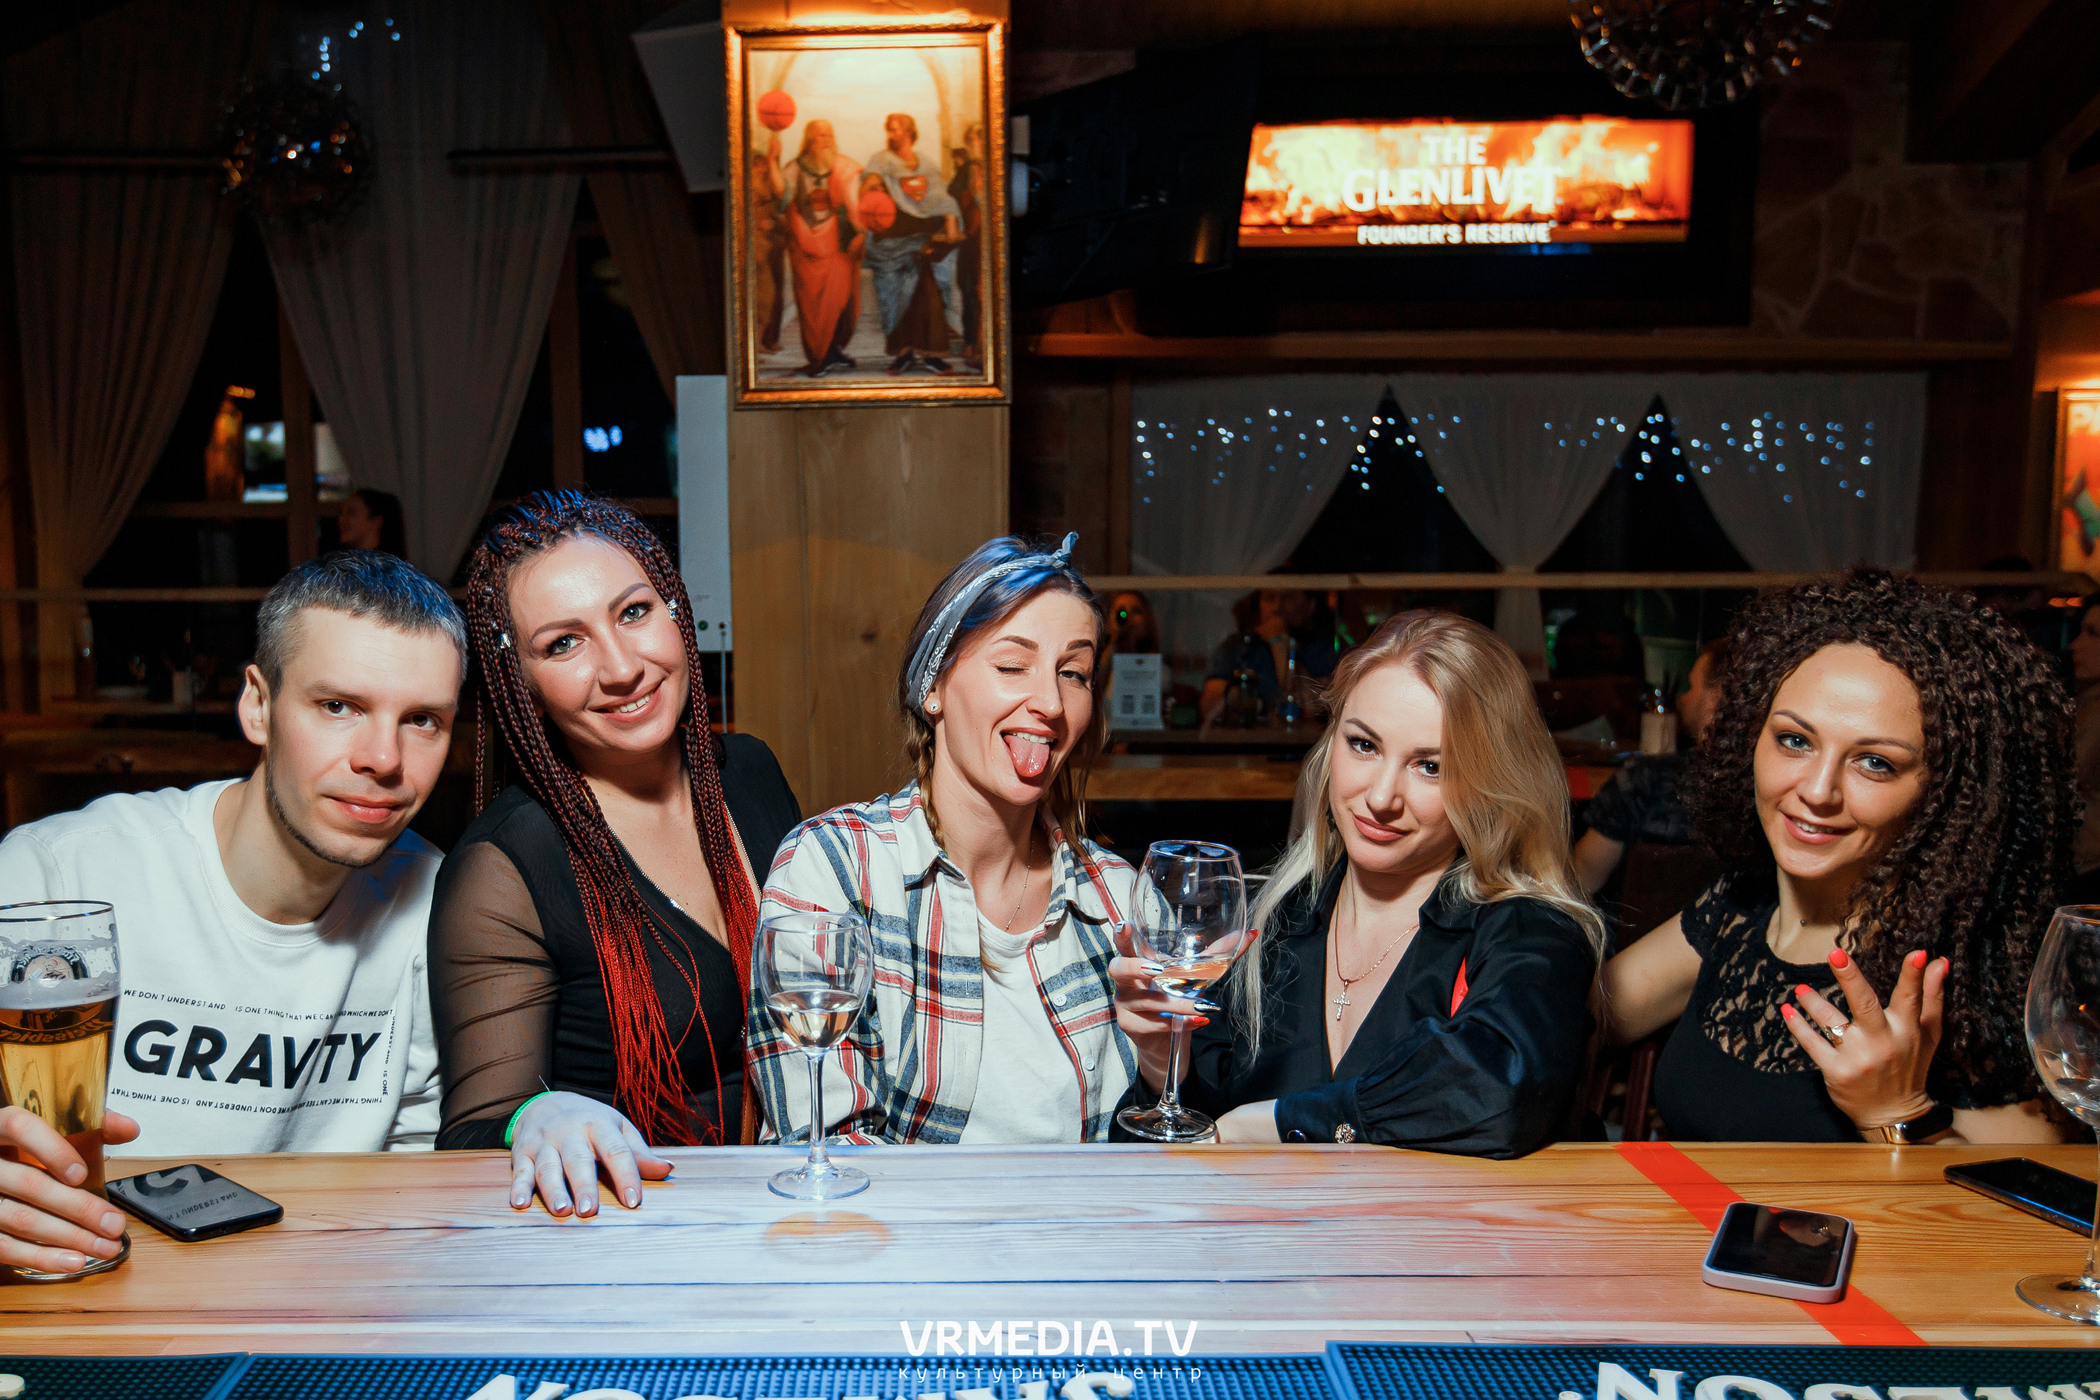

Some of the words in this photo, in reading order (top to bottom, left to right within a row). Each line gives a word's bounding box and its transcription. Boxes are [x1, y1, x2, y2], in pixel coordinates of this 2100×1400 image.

[1424, 135, 1486, 165] THE
[1342, 165, 1562, 213] GLENLIVET
[1357, 224, 1463, 244] FOUNDER'S
[1465, 223, 1551, 244] RESERVE
[235, 1005, 243, 1013] IS
[244, 1006, 262, 1014] ONE
[264, 1008, 284, 1018] THING
[285, 1012, 302, 1020] THAT
[131, 1091, 157, 1102] THING
[160, 1095, 180, 1104] ONE
[195, 1099, 253, 1112] UNDERSTAND
